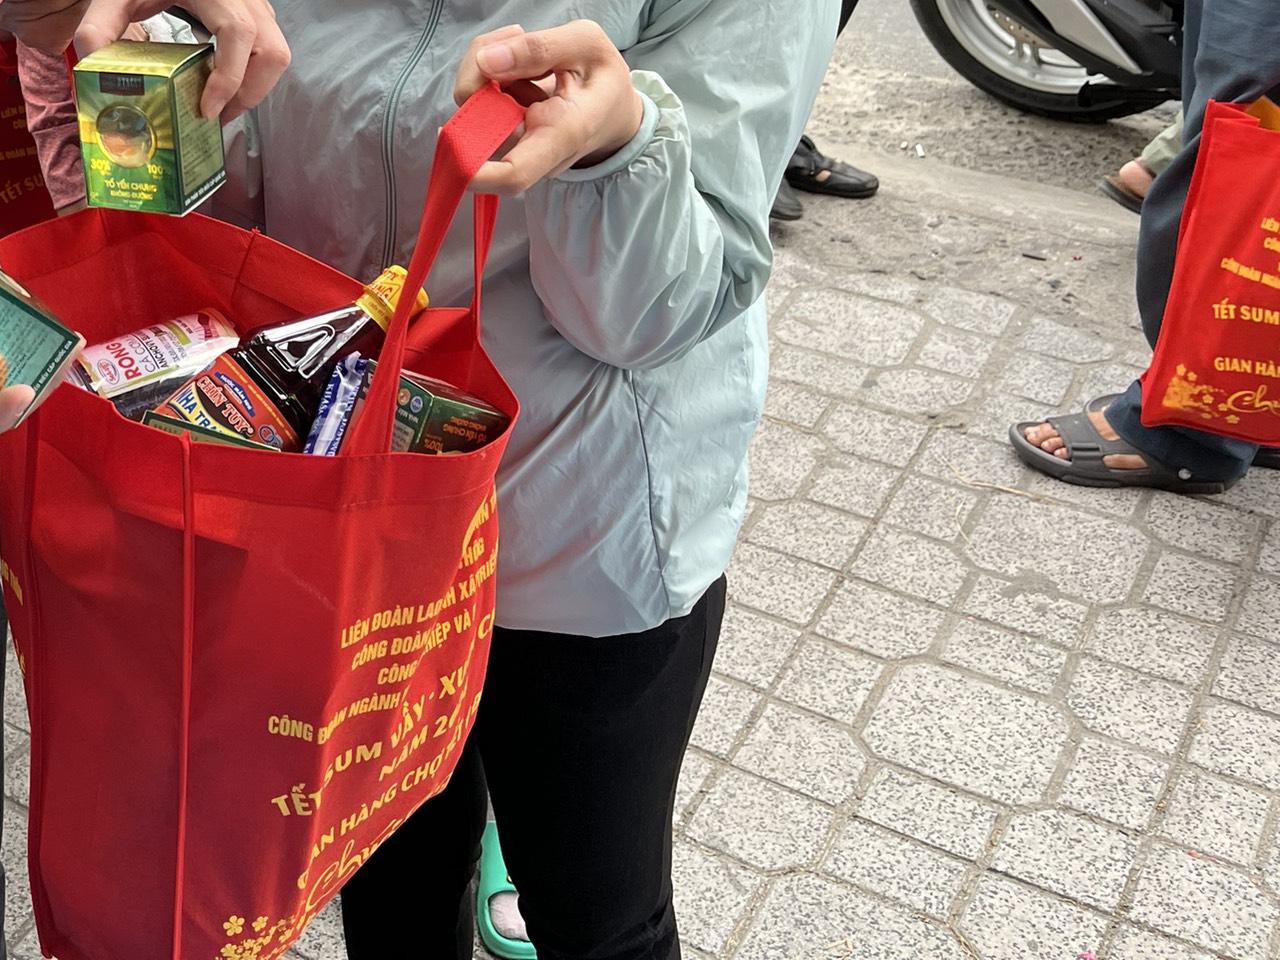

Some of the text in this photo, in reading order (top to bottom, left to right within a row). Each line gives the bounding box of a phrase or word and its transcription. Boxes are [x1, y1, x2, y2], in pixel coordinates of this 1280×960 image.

[24, 173, 45, 192] SU
[1212, 297, 1280, 325] TẾT SUM
[105, 341, 143, 382] RONG
[1214, 356, 1252, 373] GIAN
[196, 374, 228, 408] CHÍN
[194, 410, 221, 432] TRA
[340, 617, 371, 649] LIÊN
[371, 604, 415, 632] ĐOÀN
[351, 636, 388, 671] CÔNG
[376, 659, 419, 686] CÔNG
[268, 713, 314, 742] CÔNG
[347, 691, 401, 718] NGÀNH
[378, 725, 429, 782] NĂM
[271, 782, 322, 817] TẾT
[323, 741, 383, 788] SUM
[340, 783, 397, 836] HÀNG
[400, 753, 444, 792] CHỢ
